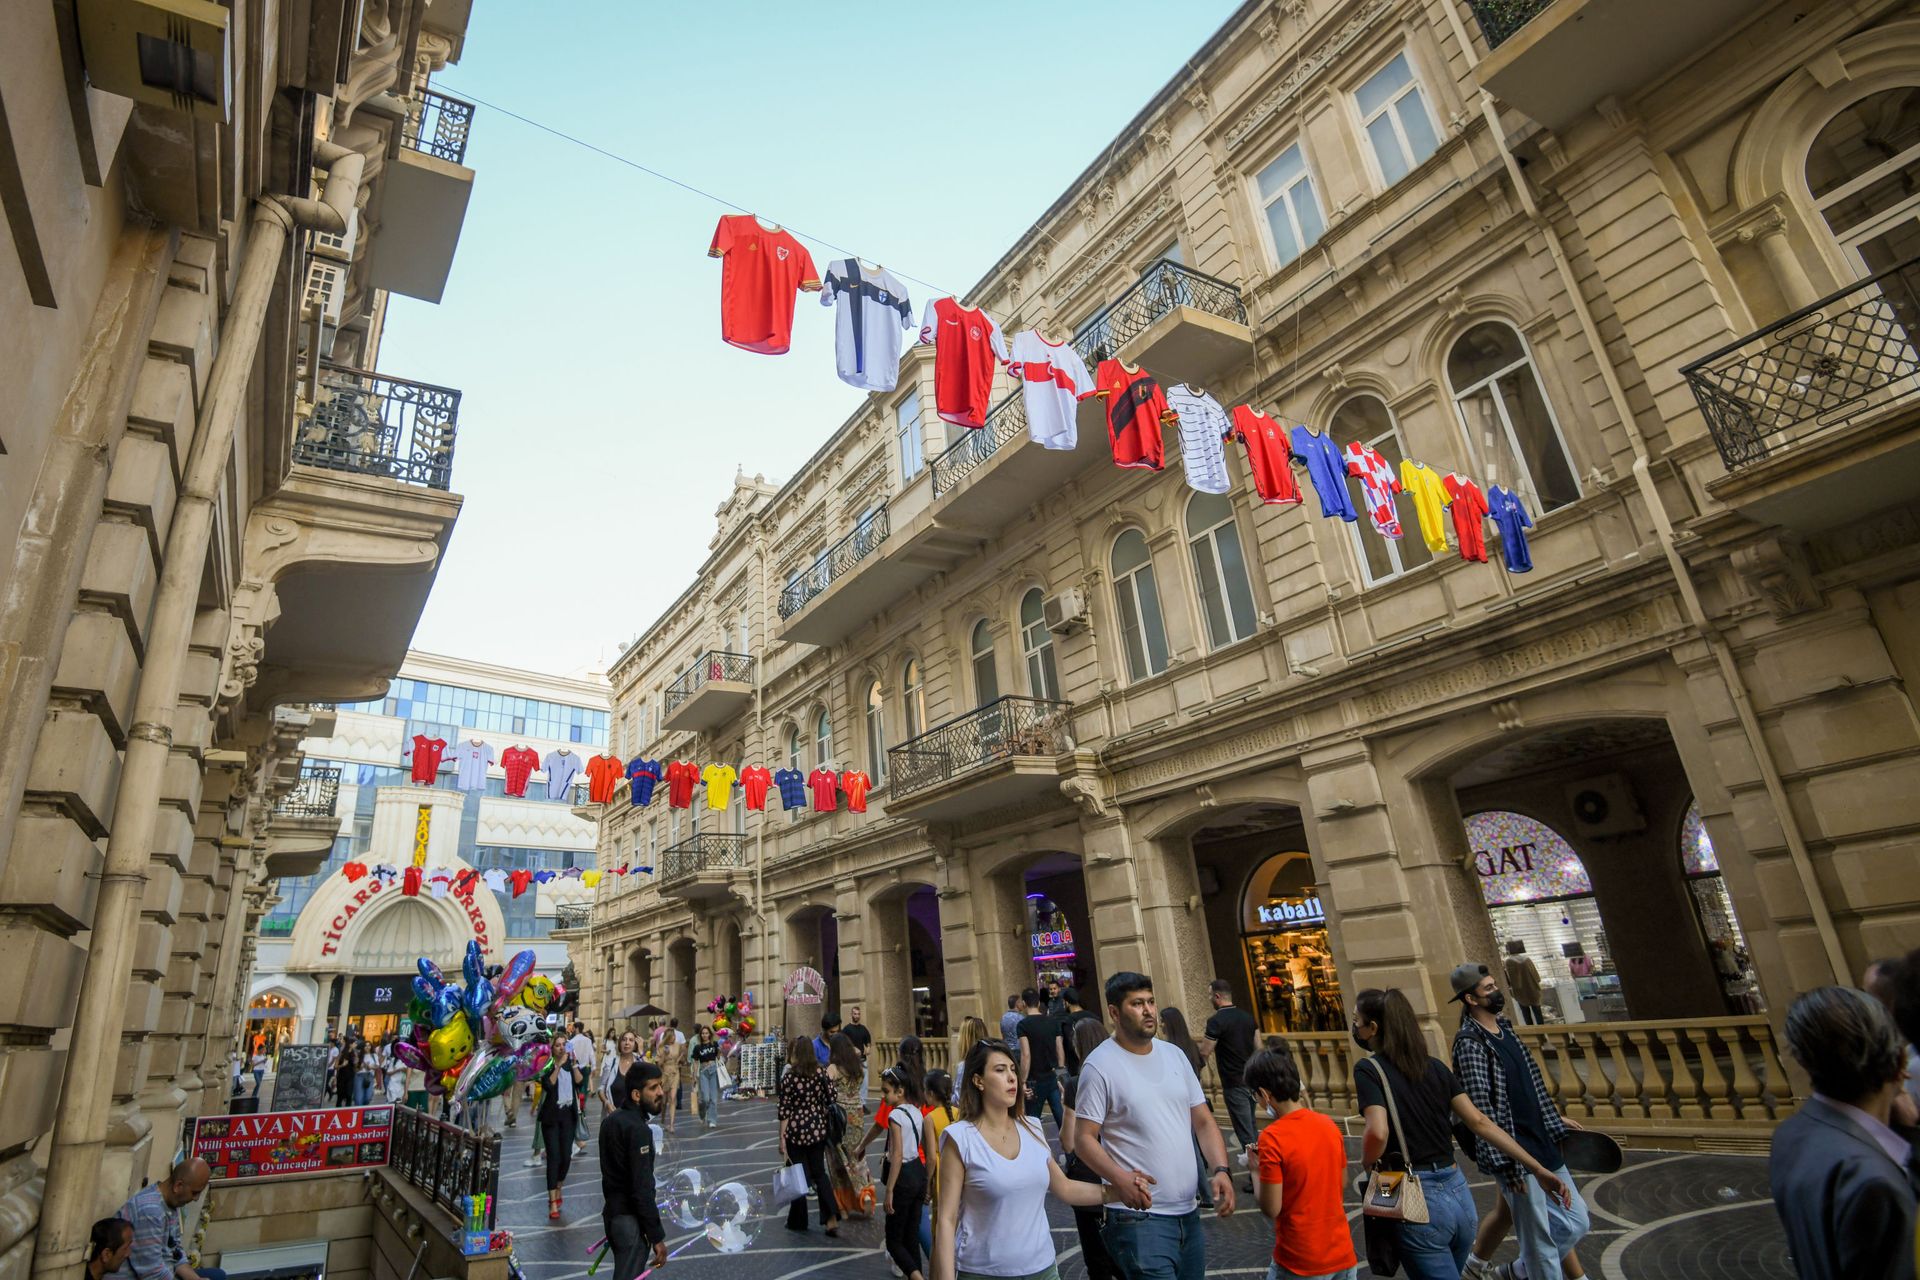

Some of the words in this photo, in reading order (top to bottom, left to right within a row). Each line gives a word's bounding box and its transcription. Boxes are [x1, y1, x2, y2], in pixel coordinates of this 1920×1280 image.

[414, 808, 431, 868] XAQAN
[1475, 842, 1536, 876] GAT
[1257, 897, 1324, 923] kaball
[1031, 929, 1073, 947] NCAQLA
[233, 1112, 358, 1136] AVANTAJ
[198, 1140, 222, 1150] Milli
[261, 1159, 322, 1173] Oyuncaqlar
